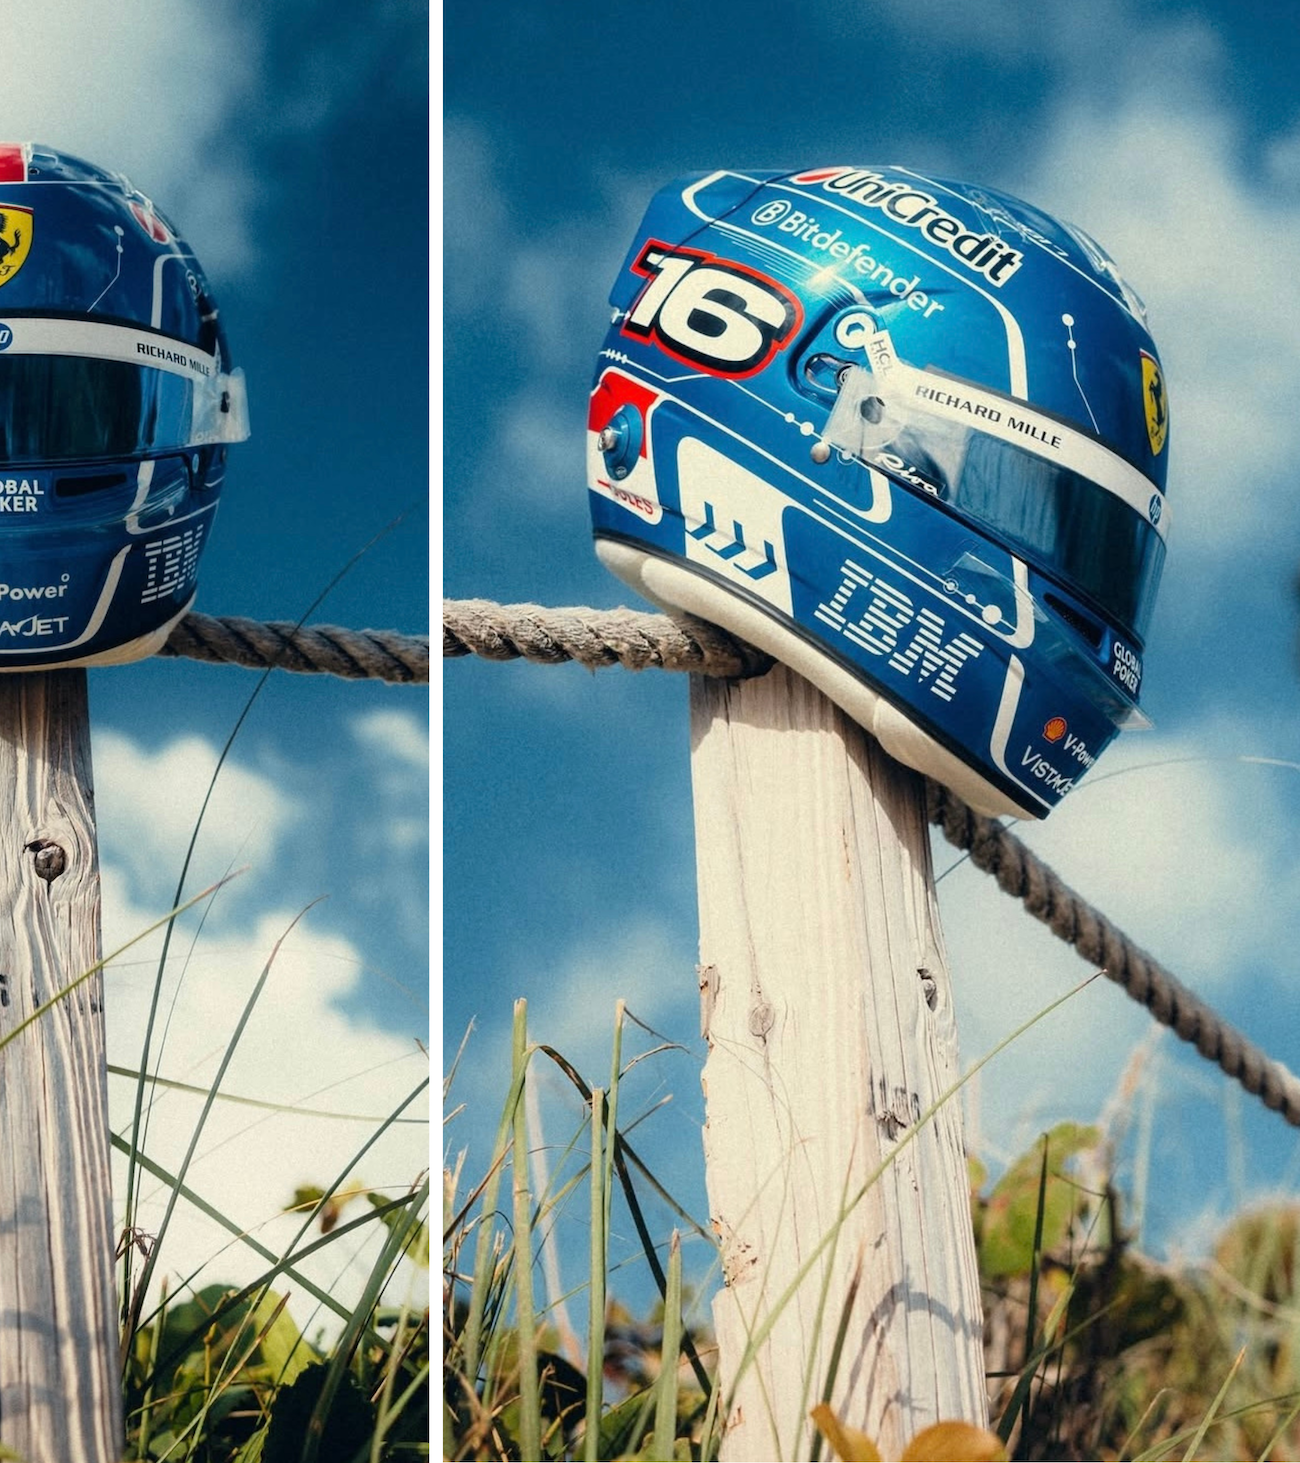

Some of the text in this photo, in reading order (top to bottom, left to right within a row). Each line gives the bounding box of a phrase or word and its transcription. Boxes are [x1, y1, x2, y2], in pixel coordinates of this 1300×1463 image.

[826, 169, 1019, 284] UniCredit
[778, 211, 945, 318] Bitdefender
[624, 244, 796, 374] 16
[136, 342, 210, 377] RICHARD MILLE
[873, 339, 894, 377] HCL
[915, 385, 1062, 449] RICHARD MILLE
[876, 453, 940, 497] Riva
[141, 524, 204, 604] IBM
[814, 559, 985, 702] IBM
[1113, 660, 1138, 694] POKER
